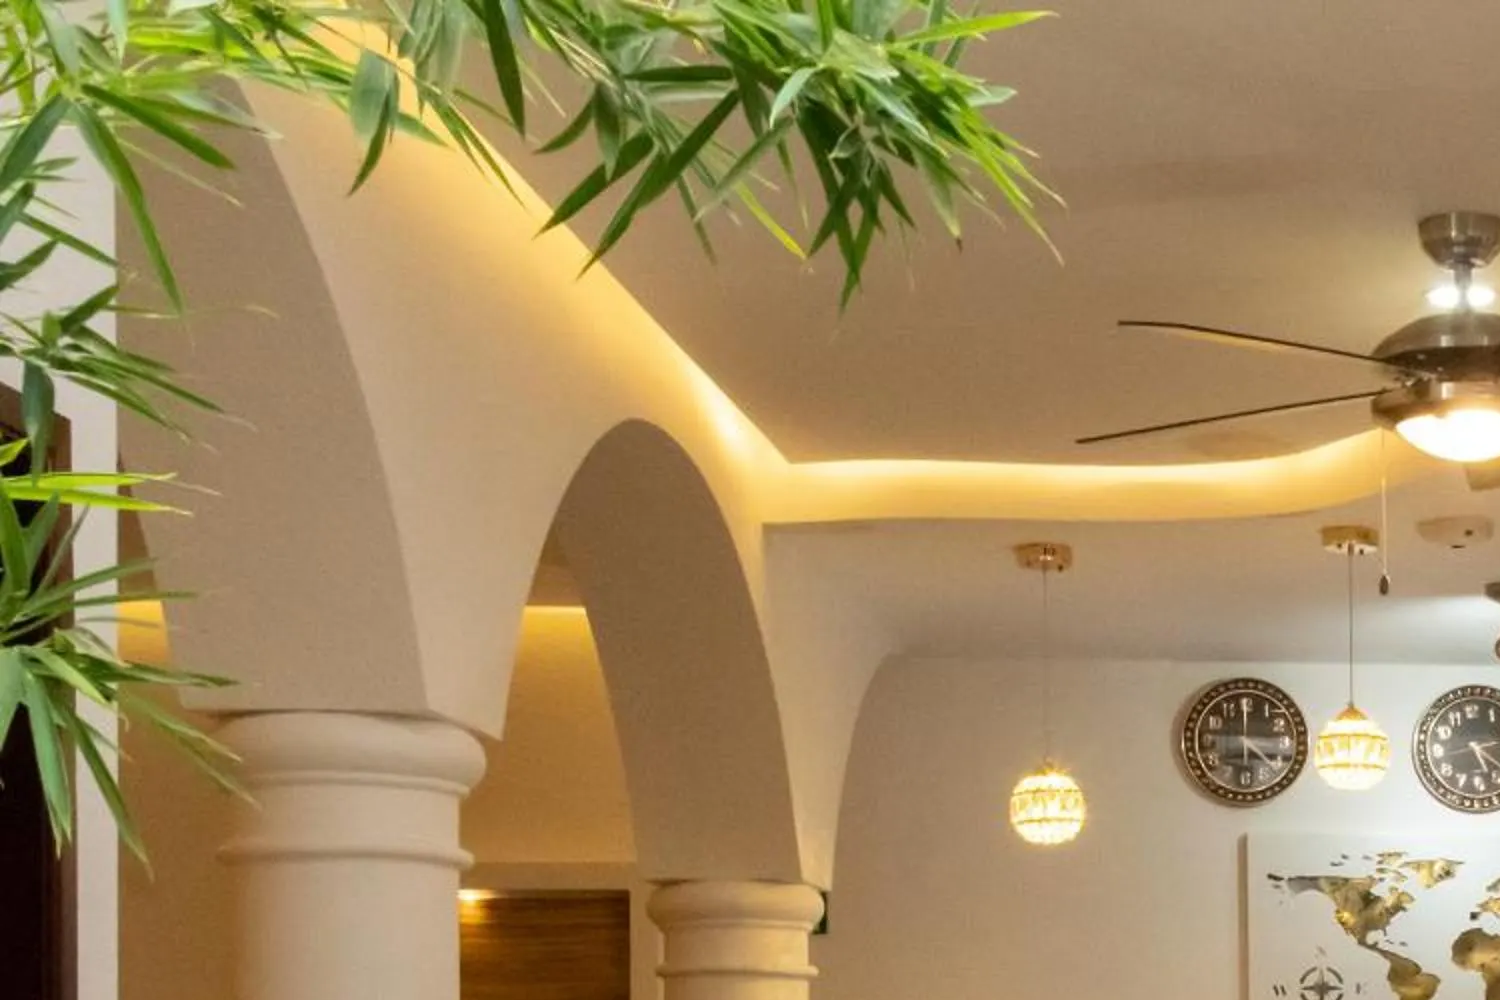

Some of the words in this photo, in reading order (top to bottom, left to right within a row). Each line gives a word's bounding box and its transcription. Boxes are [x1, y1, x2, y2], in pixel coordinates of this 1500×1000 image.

[1209, 715, 1222, 730] 10
[1448, 711, 1461, 726] 11
[1437, 725, 1452, 740] 10
[1440, 762, 1453, 777] 8
[1456, 773, 1467, 788] 7
